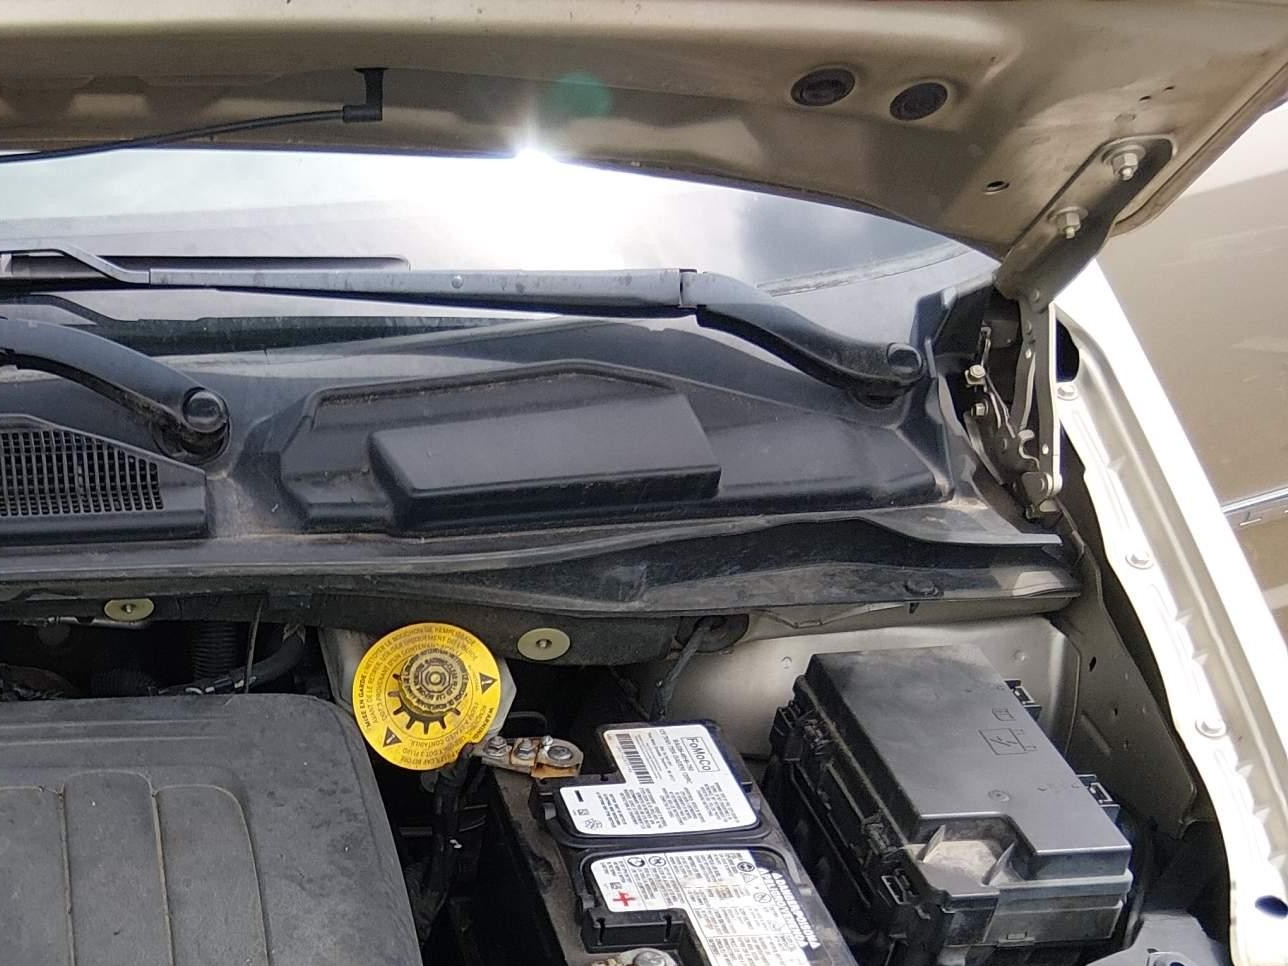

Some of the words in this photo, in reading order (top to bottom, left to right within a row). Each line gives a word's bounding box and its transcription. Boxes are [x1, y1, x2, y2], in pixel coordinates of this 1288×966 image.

[358, 674, 366, 697] GARDE
[358, 699, 365, 709] EN
[360, 709, 371, 727] MISE
[688, 737, 712, 772] FoMoCo
